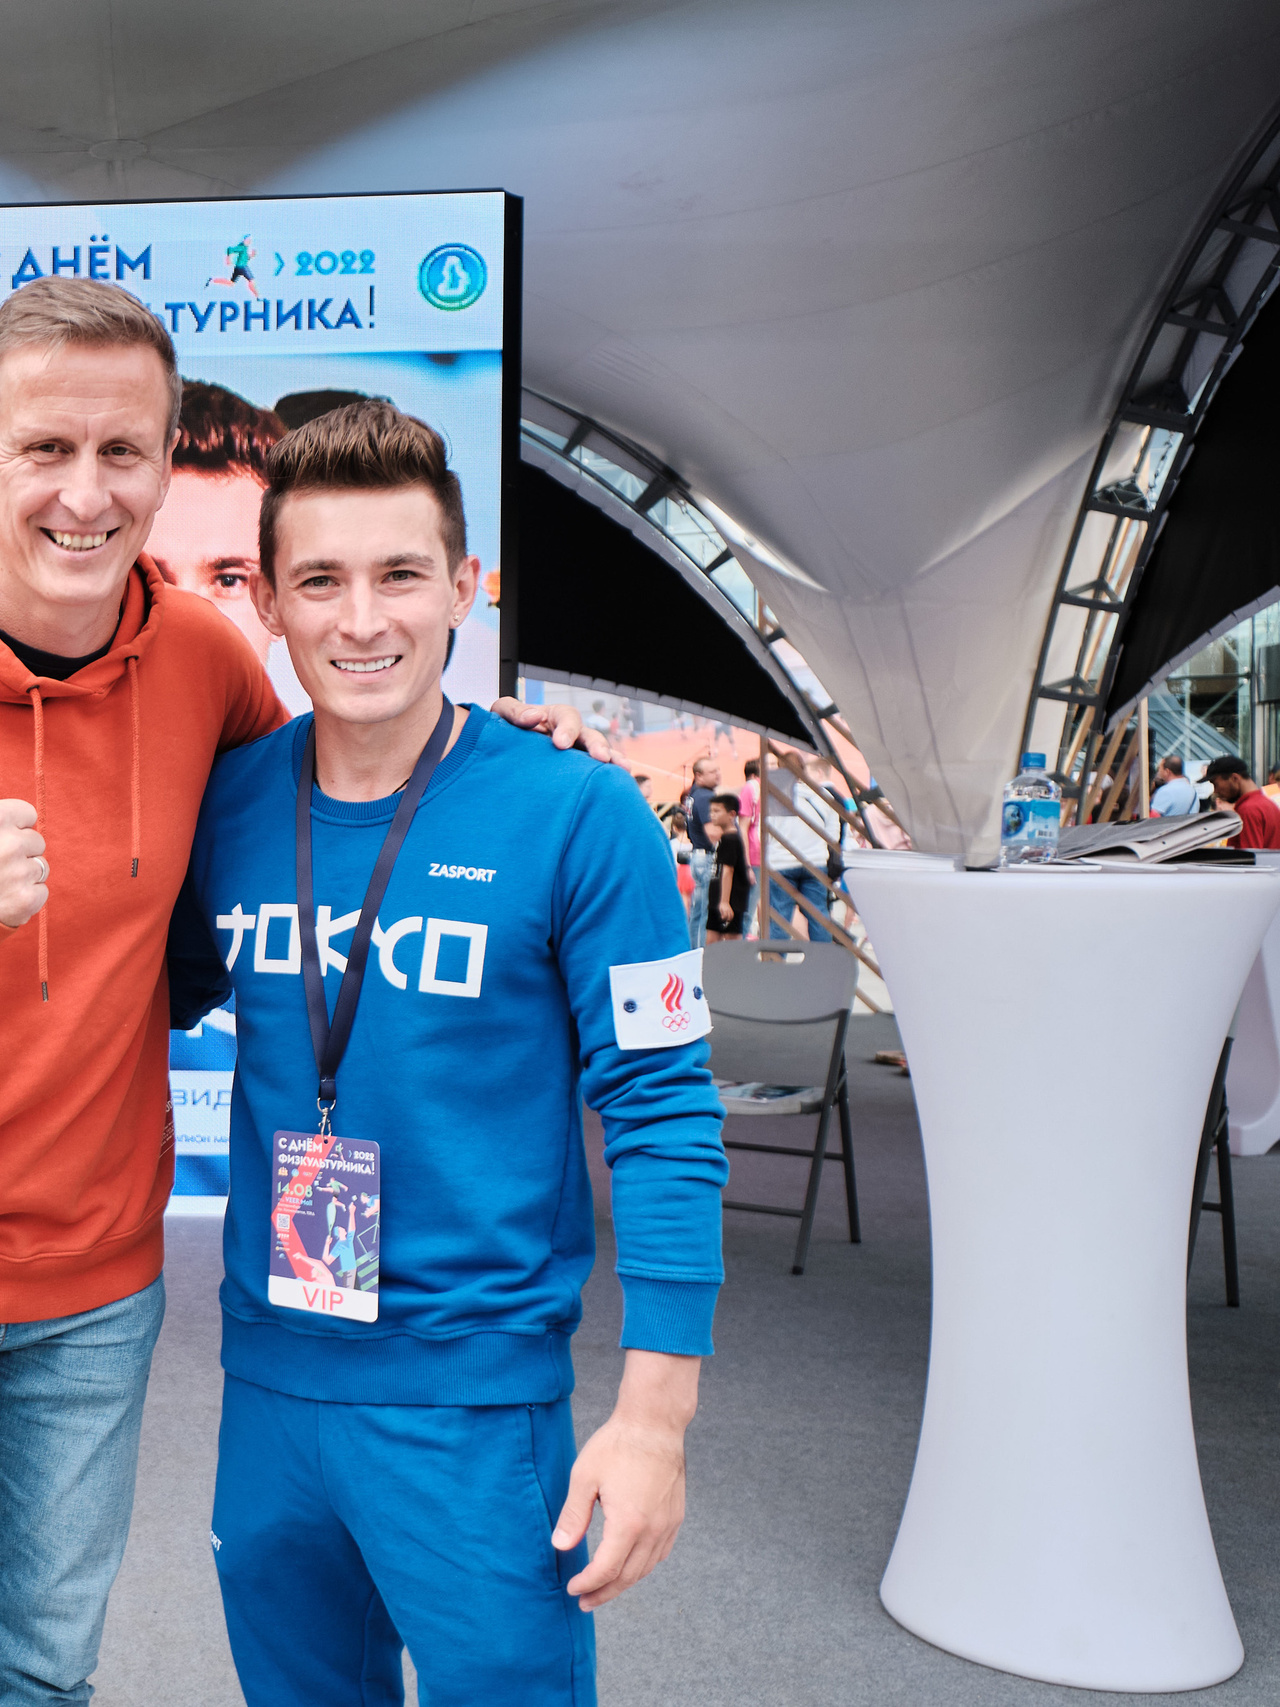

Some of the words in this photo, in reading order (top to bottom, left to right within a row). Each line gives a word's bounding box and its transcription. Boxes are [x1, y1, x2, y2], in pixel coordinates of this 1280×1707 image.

[11, 234, 153, 290] ДНЁМ
[295, 249, 376, 276] 2022
[428, 862, 497, 883] ZASPORT
[216, 902, 489, 998] TOKYO
[277, 1137, 288, 1150] С
[288, 1138, 323, 1153] ДНЁМ
[353, 1150, 375, 1161] 2022
[277, 1153, 376, 1175] ФИЗКУЛЬТУРНИКА!
[277, 1181, 313, 1198] 14.08
[302, 1285, 344, 1311] VIP
